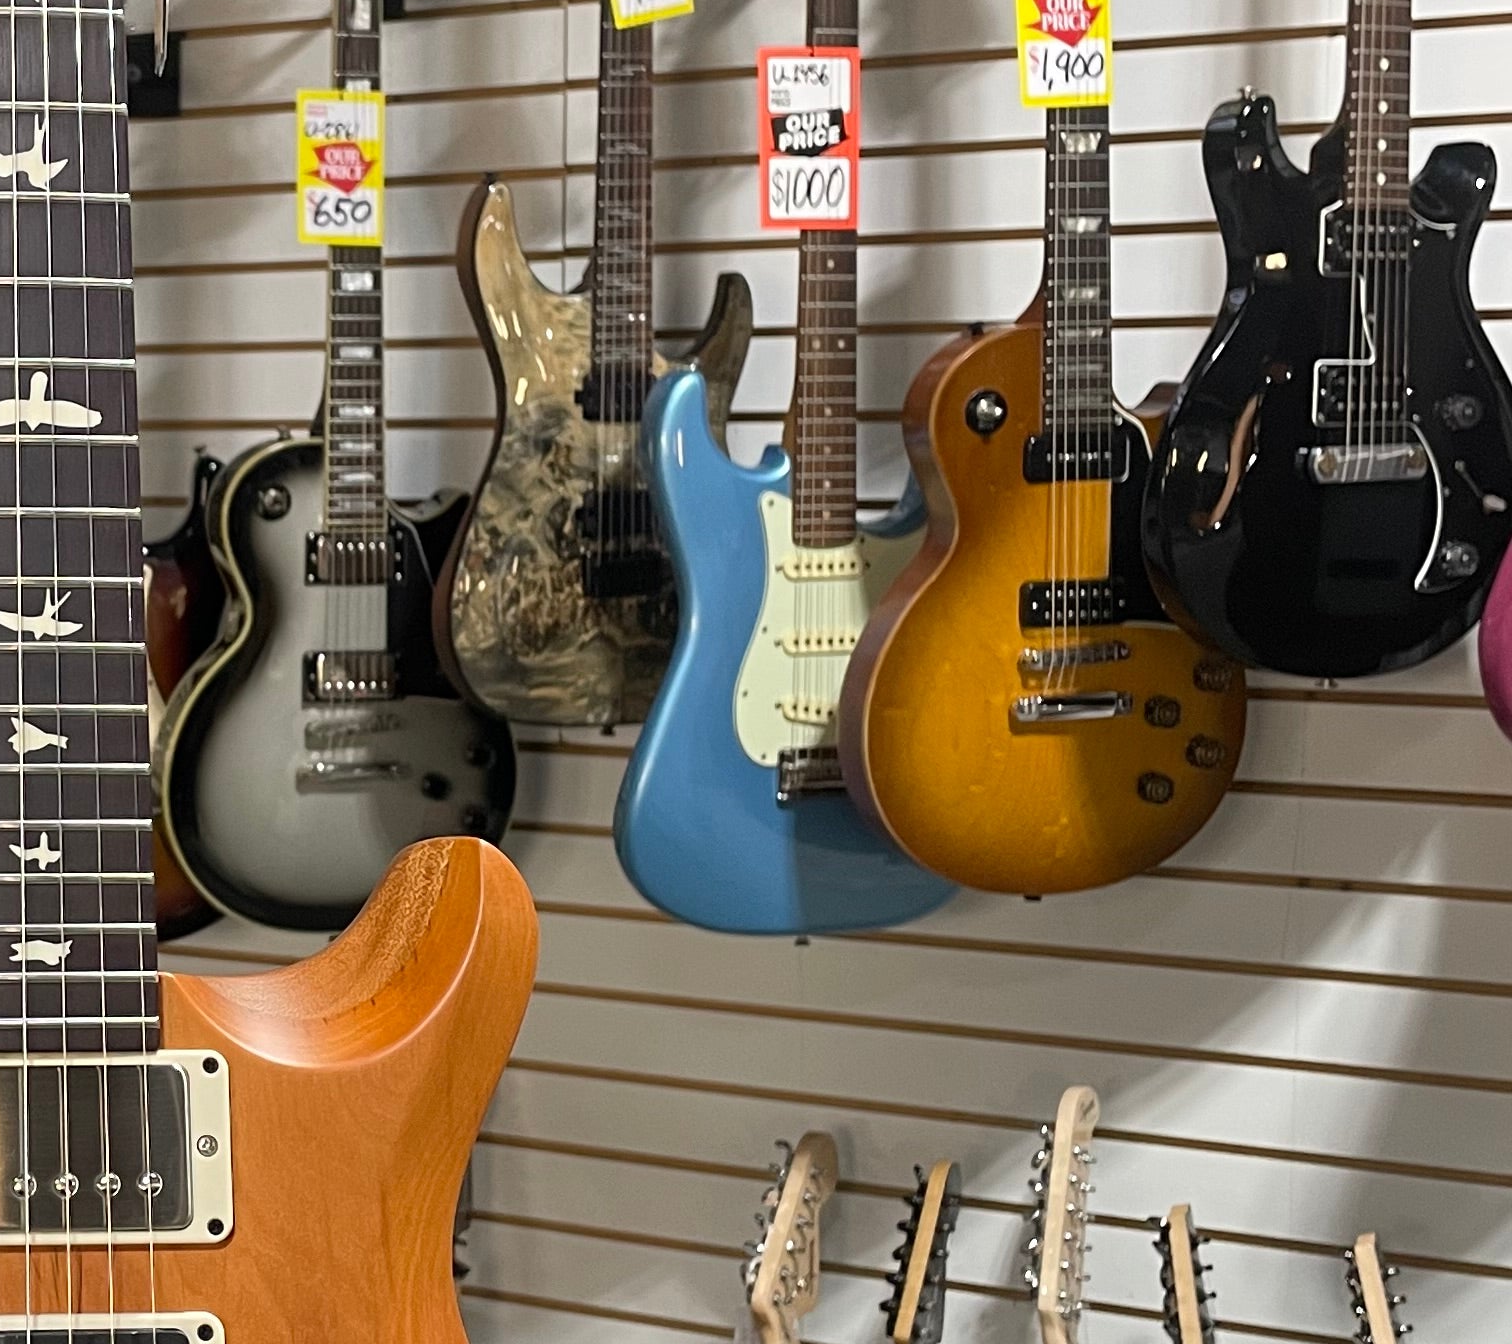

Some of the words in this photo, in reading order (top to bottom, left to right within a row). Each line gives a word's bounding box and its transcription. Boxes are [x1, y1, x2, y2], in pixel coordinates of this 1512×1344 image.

[1041, 10, 1092, 33] PRICE
[1029, 45, 1105, 92] $1,900
[785, 112, 830, 133] OUR
[778, 124, 841, 153] PRICE
[324, 146, 361, 165] OUR
[320, 163, 363, 182] PRICE
[771, 164, 846, 215] $1000
[306, 190, 372, 228] $650
